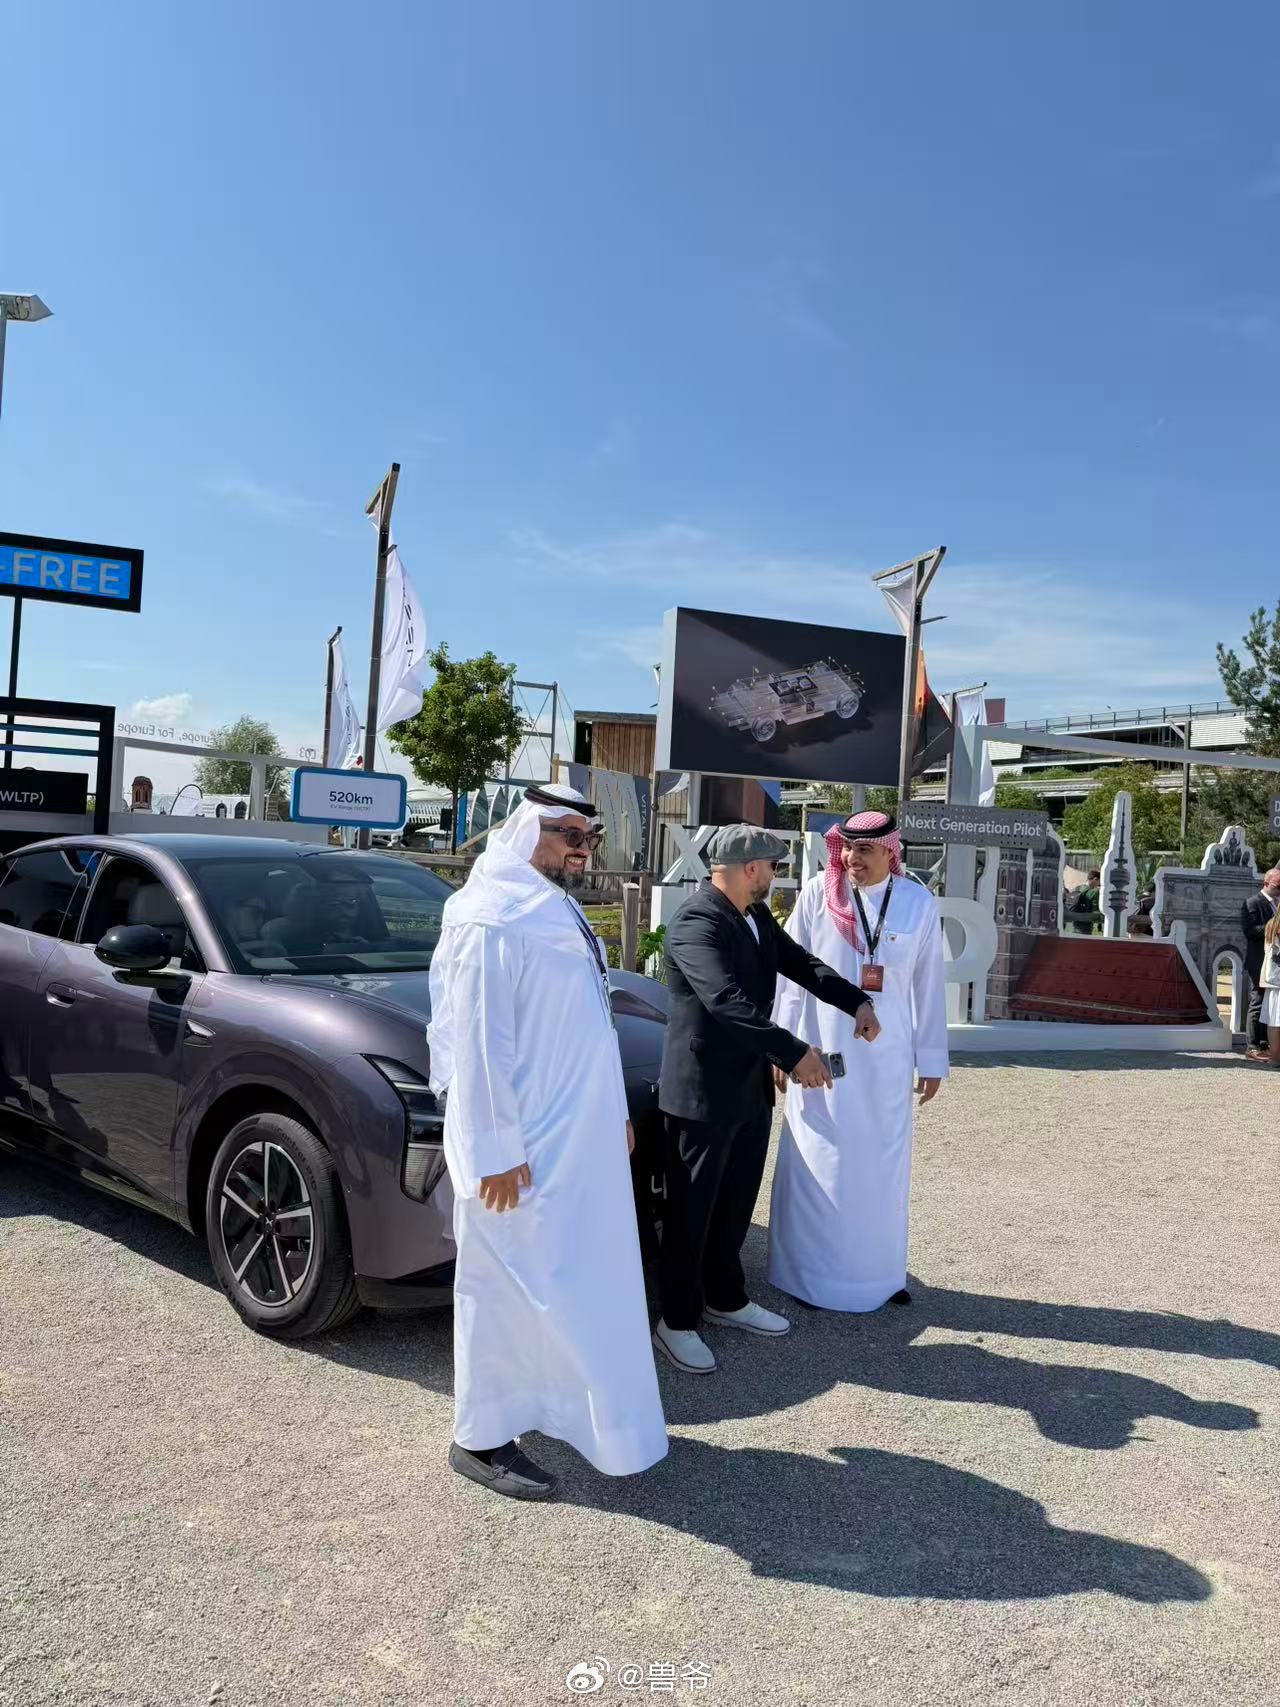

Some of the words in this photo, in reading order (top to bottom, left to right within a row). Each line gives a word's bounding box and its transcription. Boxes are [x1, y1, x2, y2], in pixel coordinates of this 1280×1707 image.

[329, 791, 373, 805] 520km
[905, 815, 937, 831] Next
[940, 817, 1010, 835] Generation
[1013, 822, 1041, 837] Pilot
